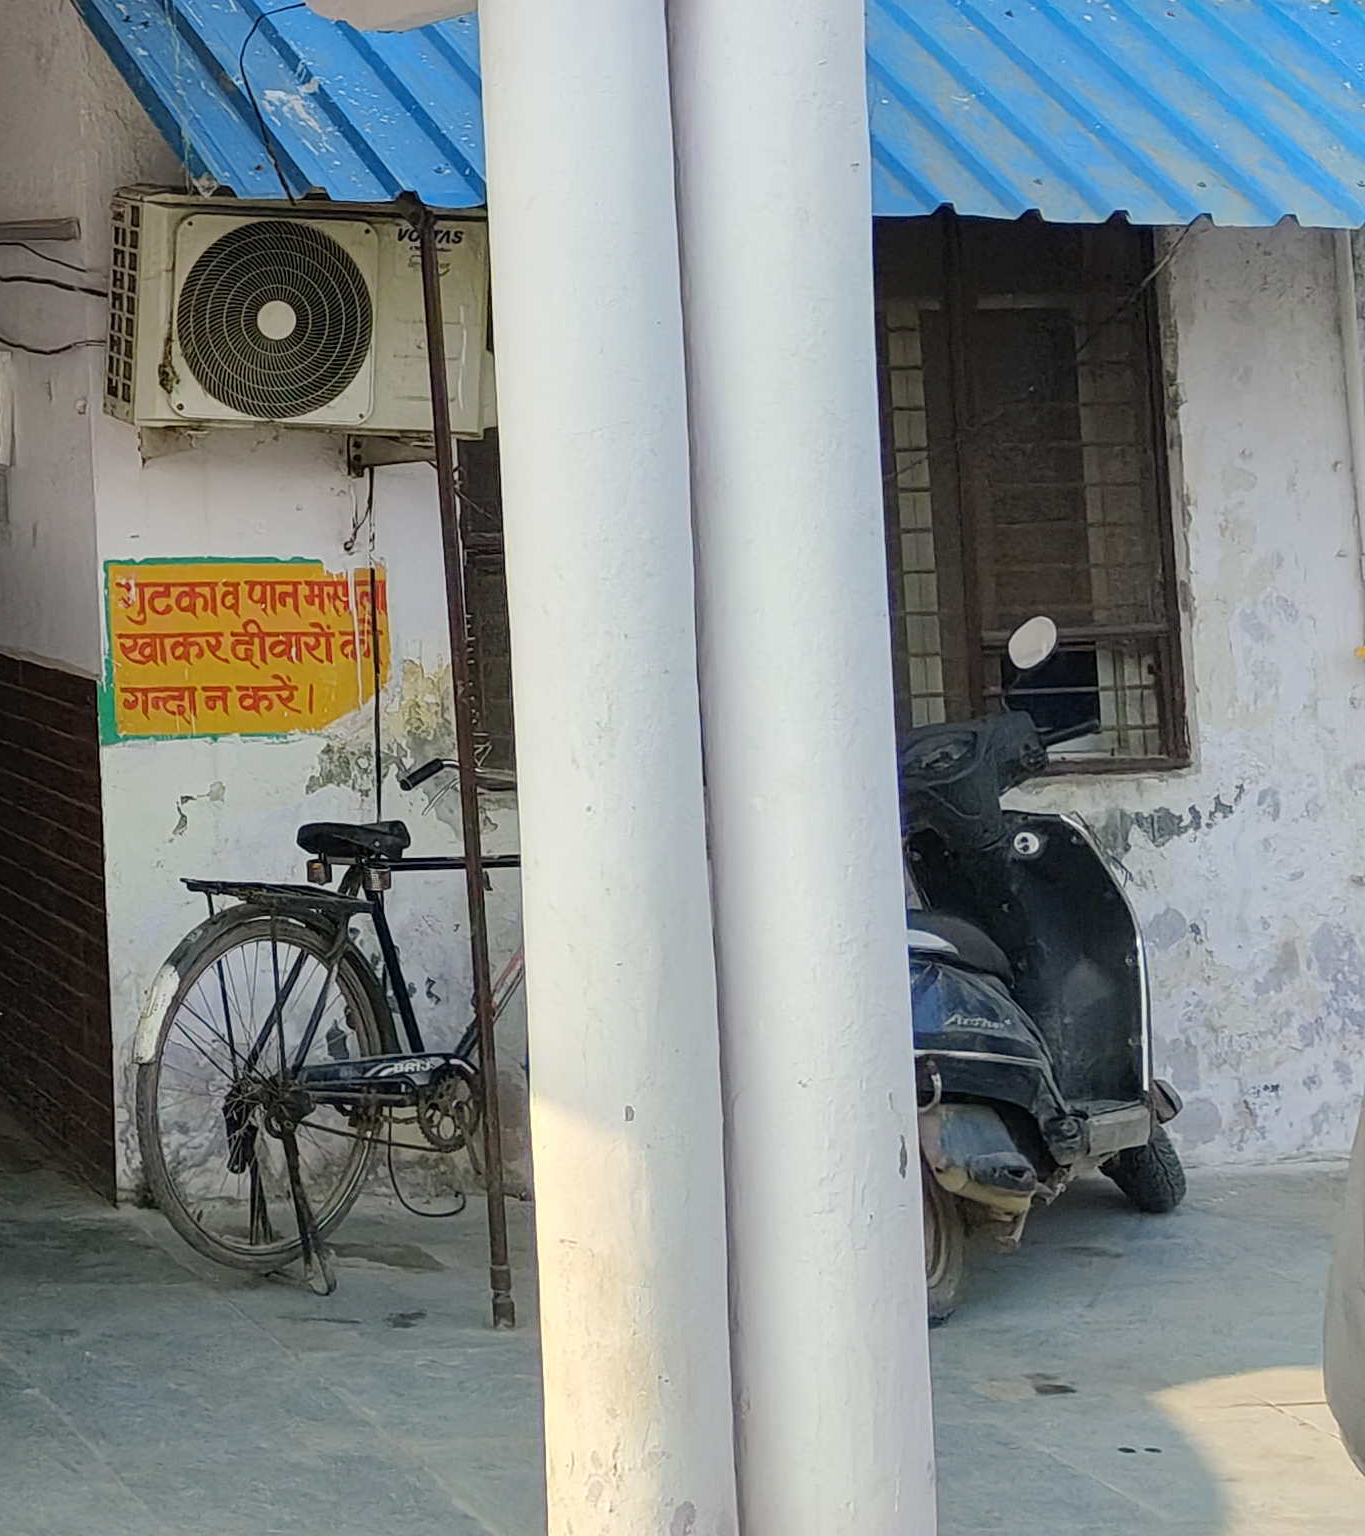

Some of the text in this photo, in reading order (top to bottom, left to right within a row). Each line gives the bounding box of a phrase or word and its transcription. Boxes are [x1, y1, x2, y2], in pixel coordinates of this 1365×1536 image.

[397, 228, 464, 244] VOTAS
[244, 580, 303, 619] पान
[116, 630, 230, 666] खाकर
[230, 619, 336, 669] दीवारों
[119, 686, 198, 724] गन्दा
[200, 686, 231, 717] न
